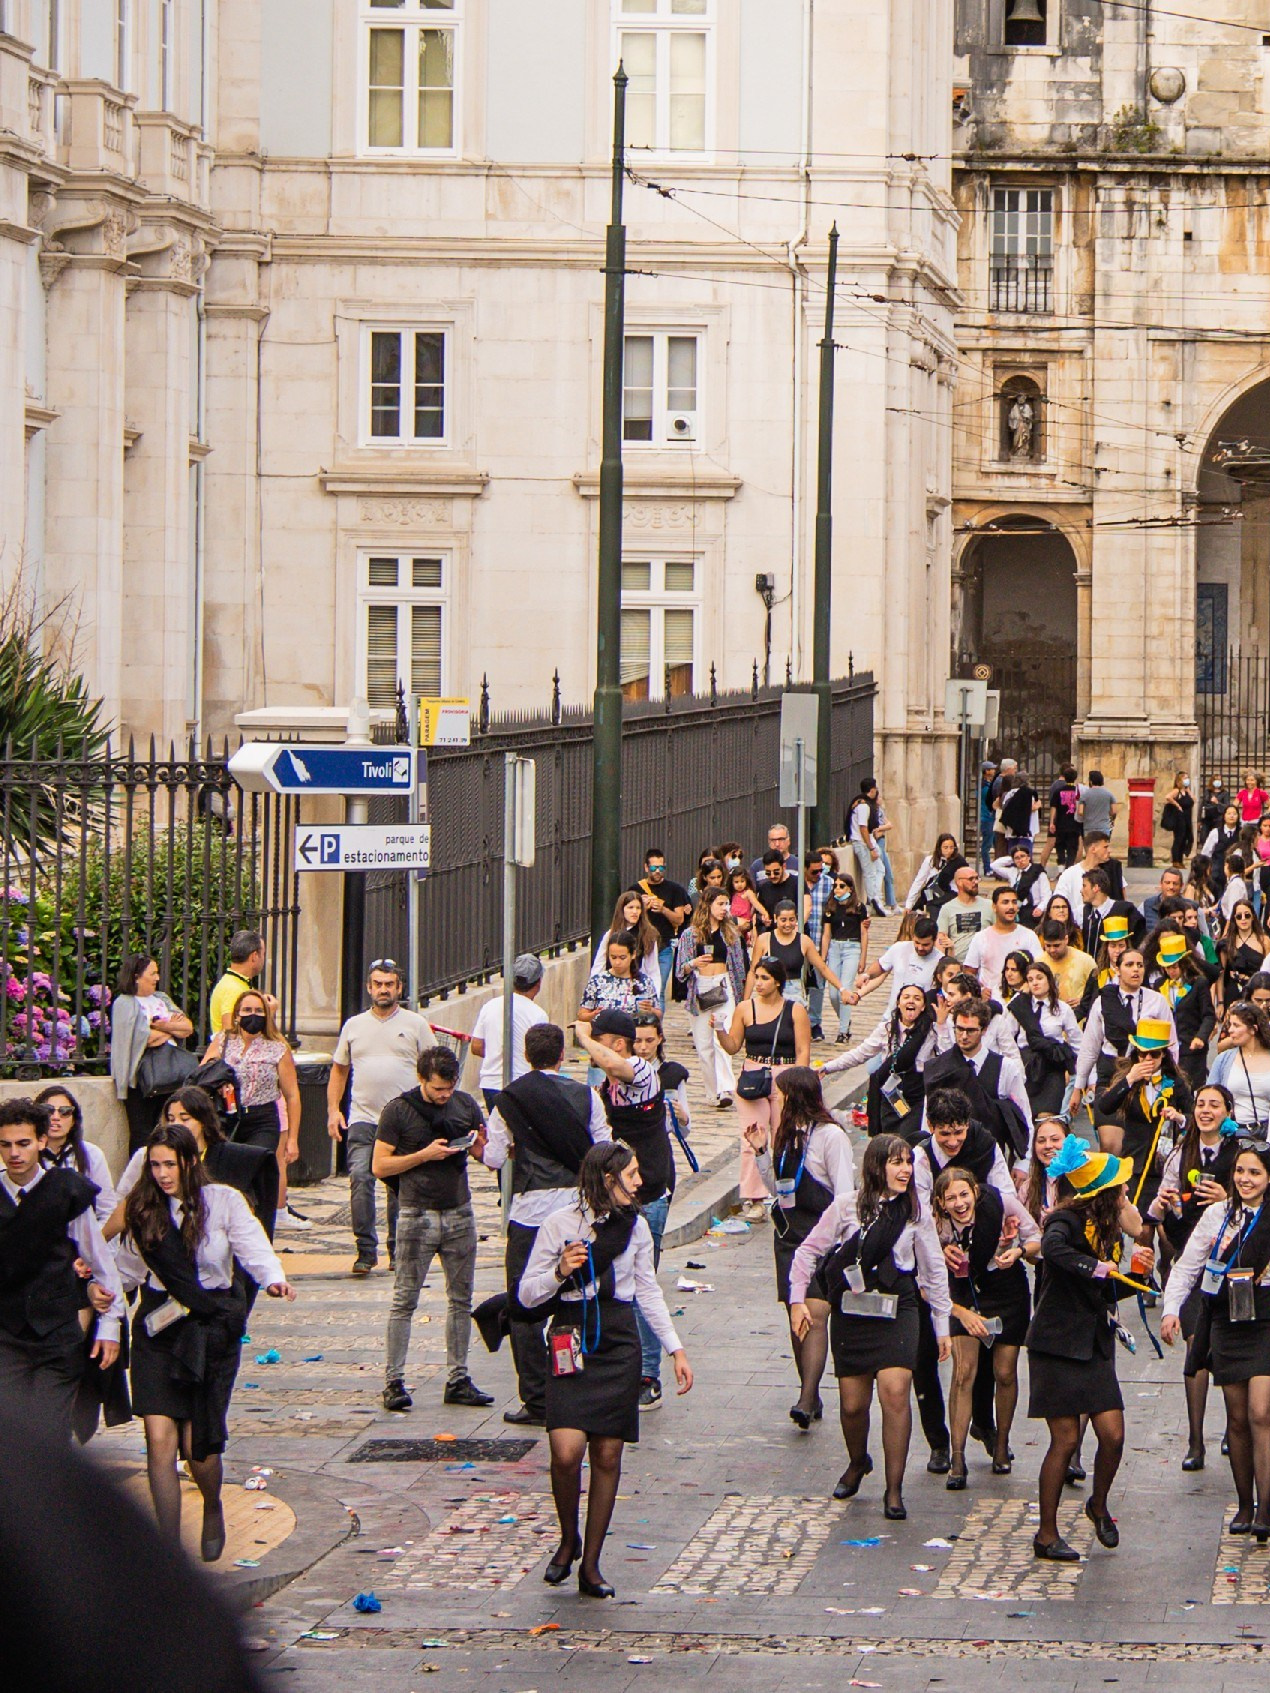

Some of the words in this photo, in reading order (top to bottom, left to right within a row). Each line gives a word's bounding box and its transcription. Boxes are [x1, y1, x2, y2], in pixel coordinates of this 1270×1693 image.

[361, 761, 392, 778] Tivoli
[385, 836, 415, 846] parque
[419, 834, 429, 844] de
[323, 837, 337, 861] P
[344, 850, 429, 863] estacionamento
